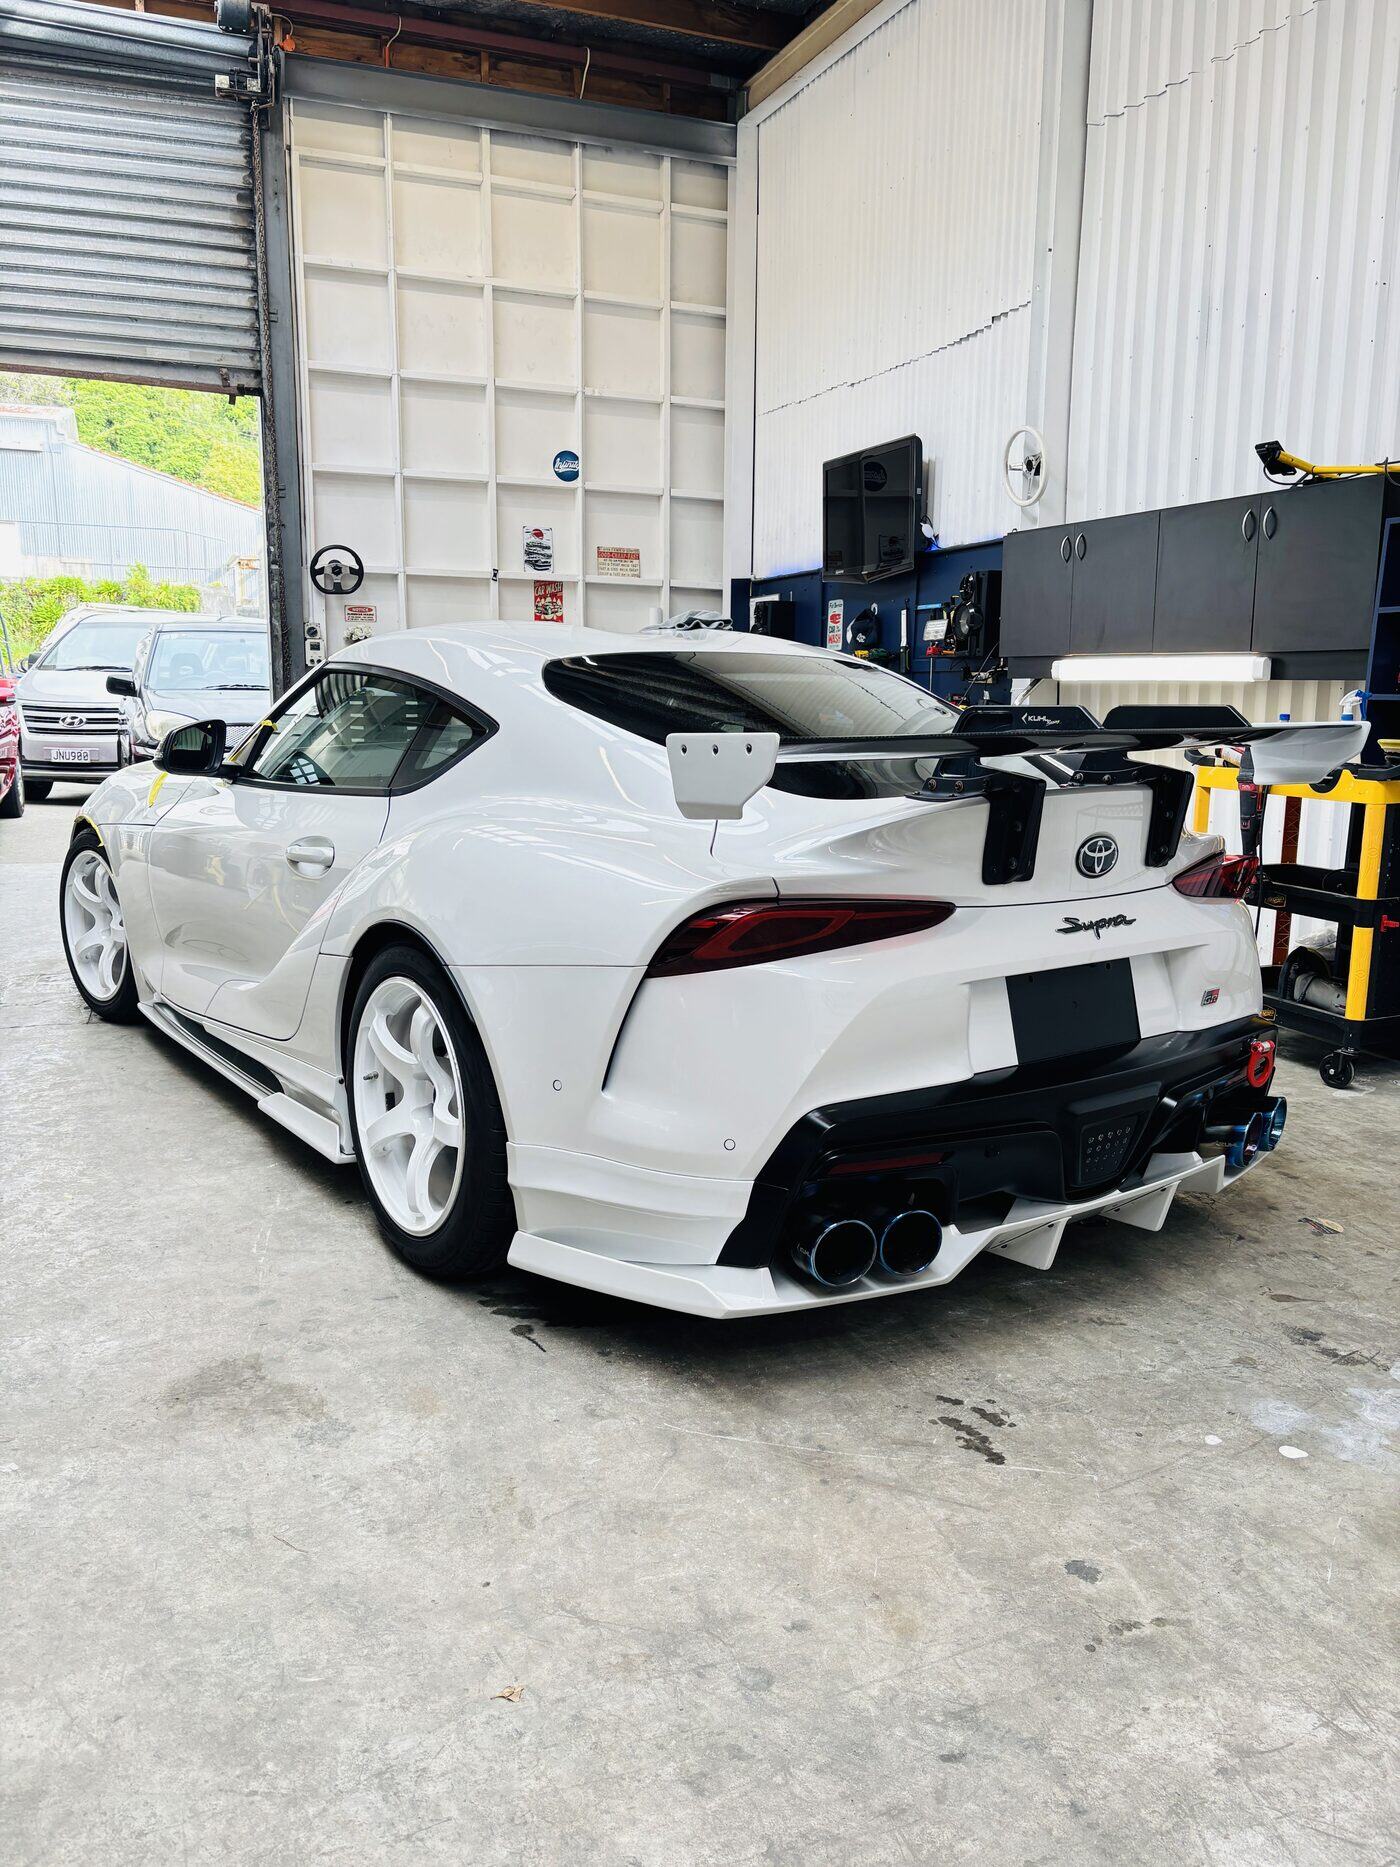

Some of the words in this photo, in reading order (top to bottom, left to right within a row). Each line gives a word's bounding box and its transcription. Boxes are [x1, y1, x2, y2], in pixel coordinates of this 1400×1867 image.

[535, 585, 545, 596] CAR
[546, 582, 563, 594] WASH
[53, 751, 89, 761] JNU900
[1055, 914, 1137, 940] Supra
